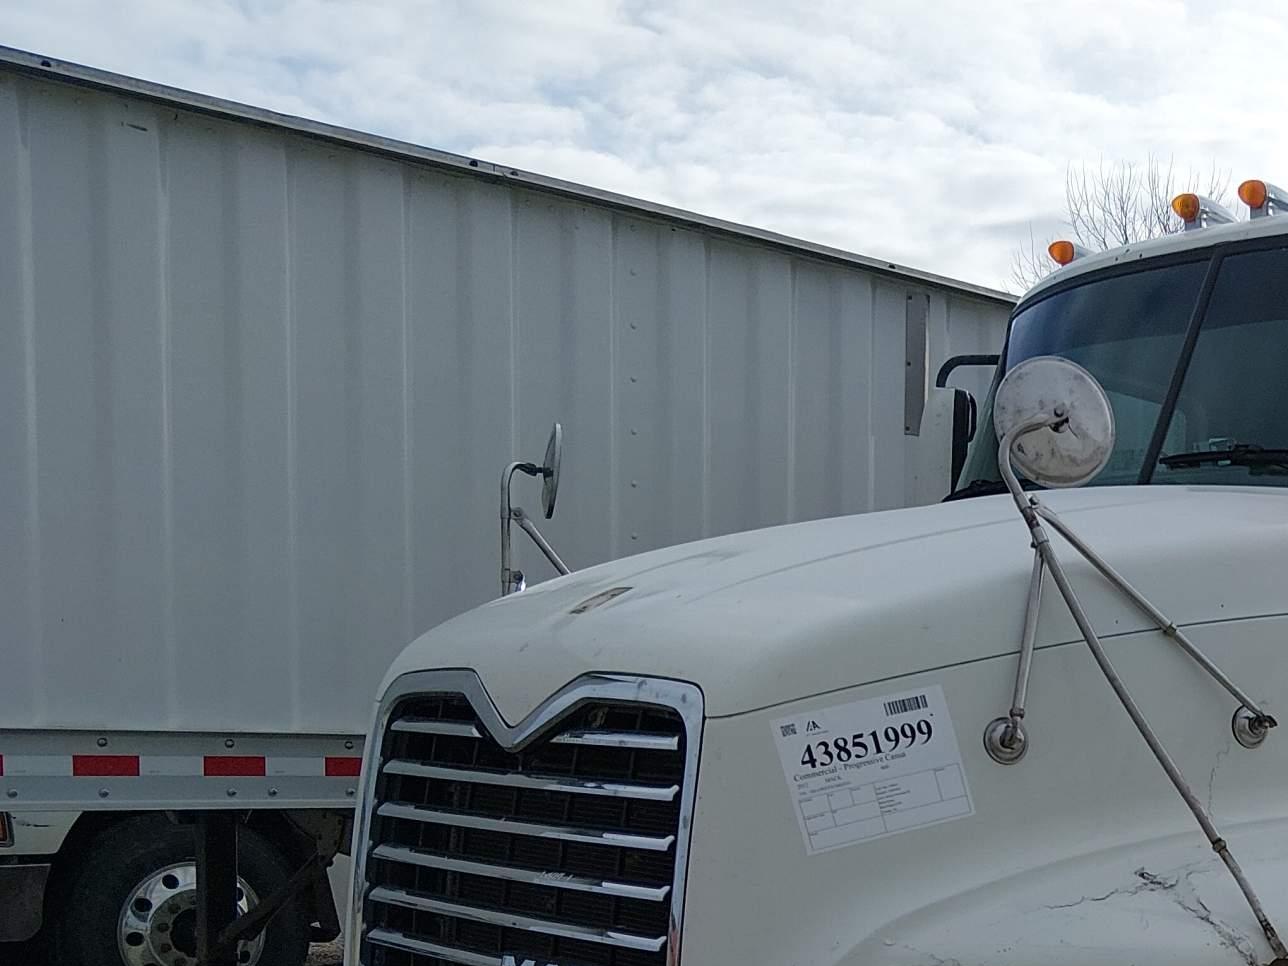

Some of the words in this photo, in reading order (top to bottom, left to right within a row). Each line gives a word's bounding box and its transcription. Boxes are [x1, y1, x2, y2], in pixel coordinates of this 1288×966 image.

[801, 719, 933, 769] 43851999
[793, 766, 838, 782] Commercial
[844, 755, 884, 771] Progressive
